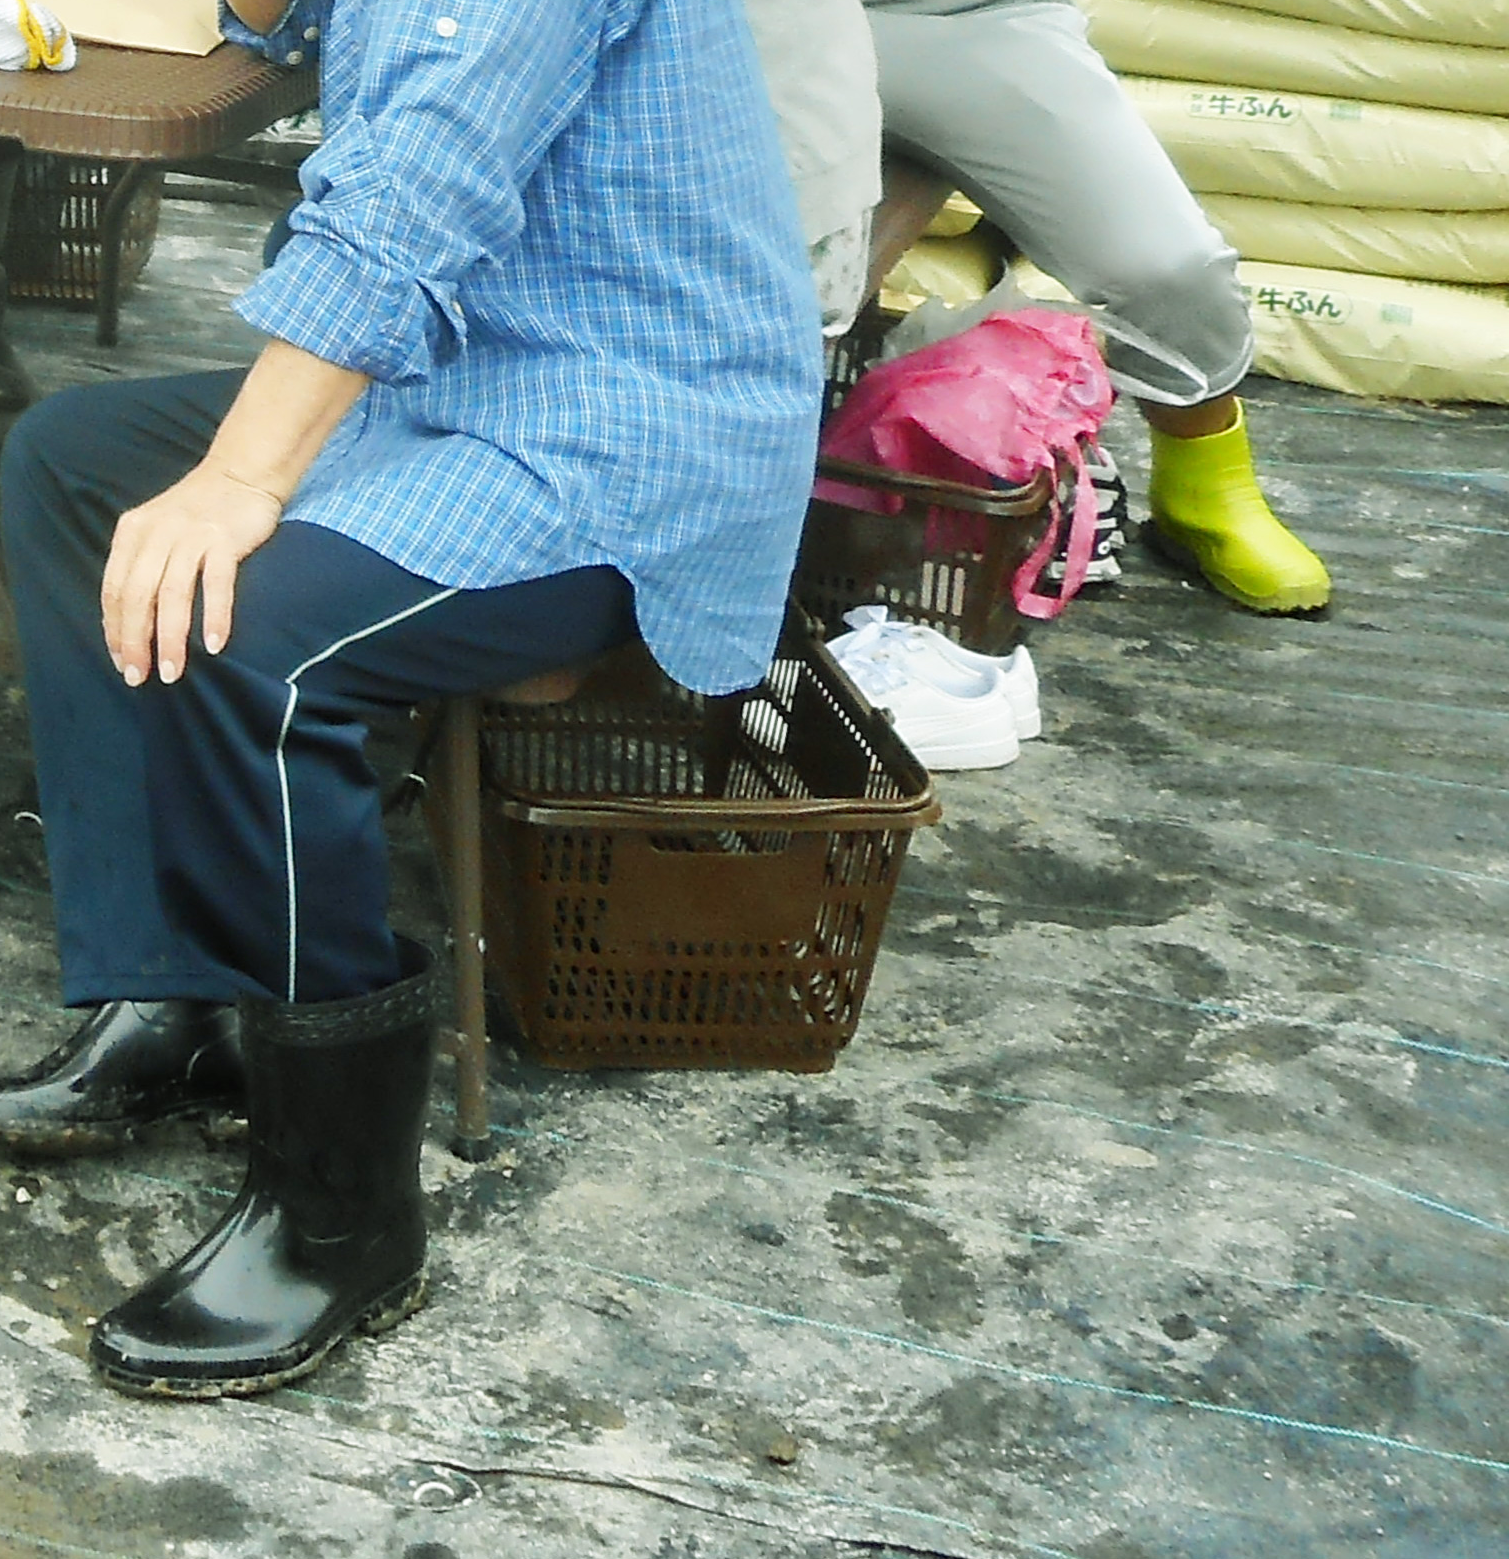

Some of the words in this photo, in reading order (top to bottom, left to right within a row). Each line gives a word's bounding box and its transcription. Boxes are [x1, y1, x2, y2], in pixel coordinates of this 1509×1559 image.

[1208, 93, 1293, 120] 牛ふん
[1257, 287, 1341, 318] 牛ふん
